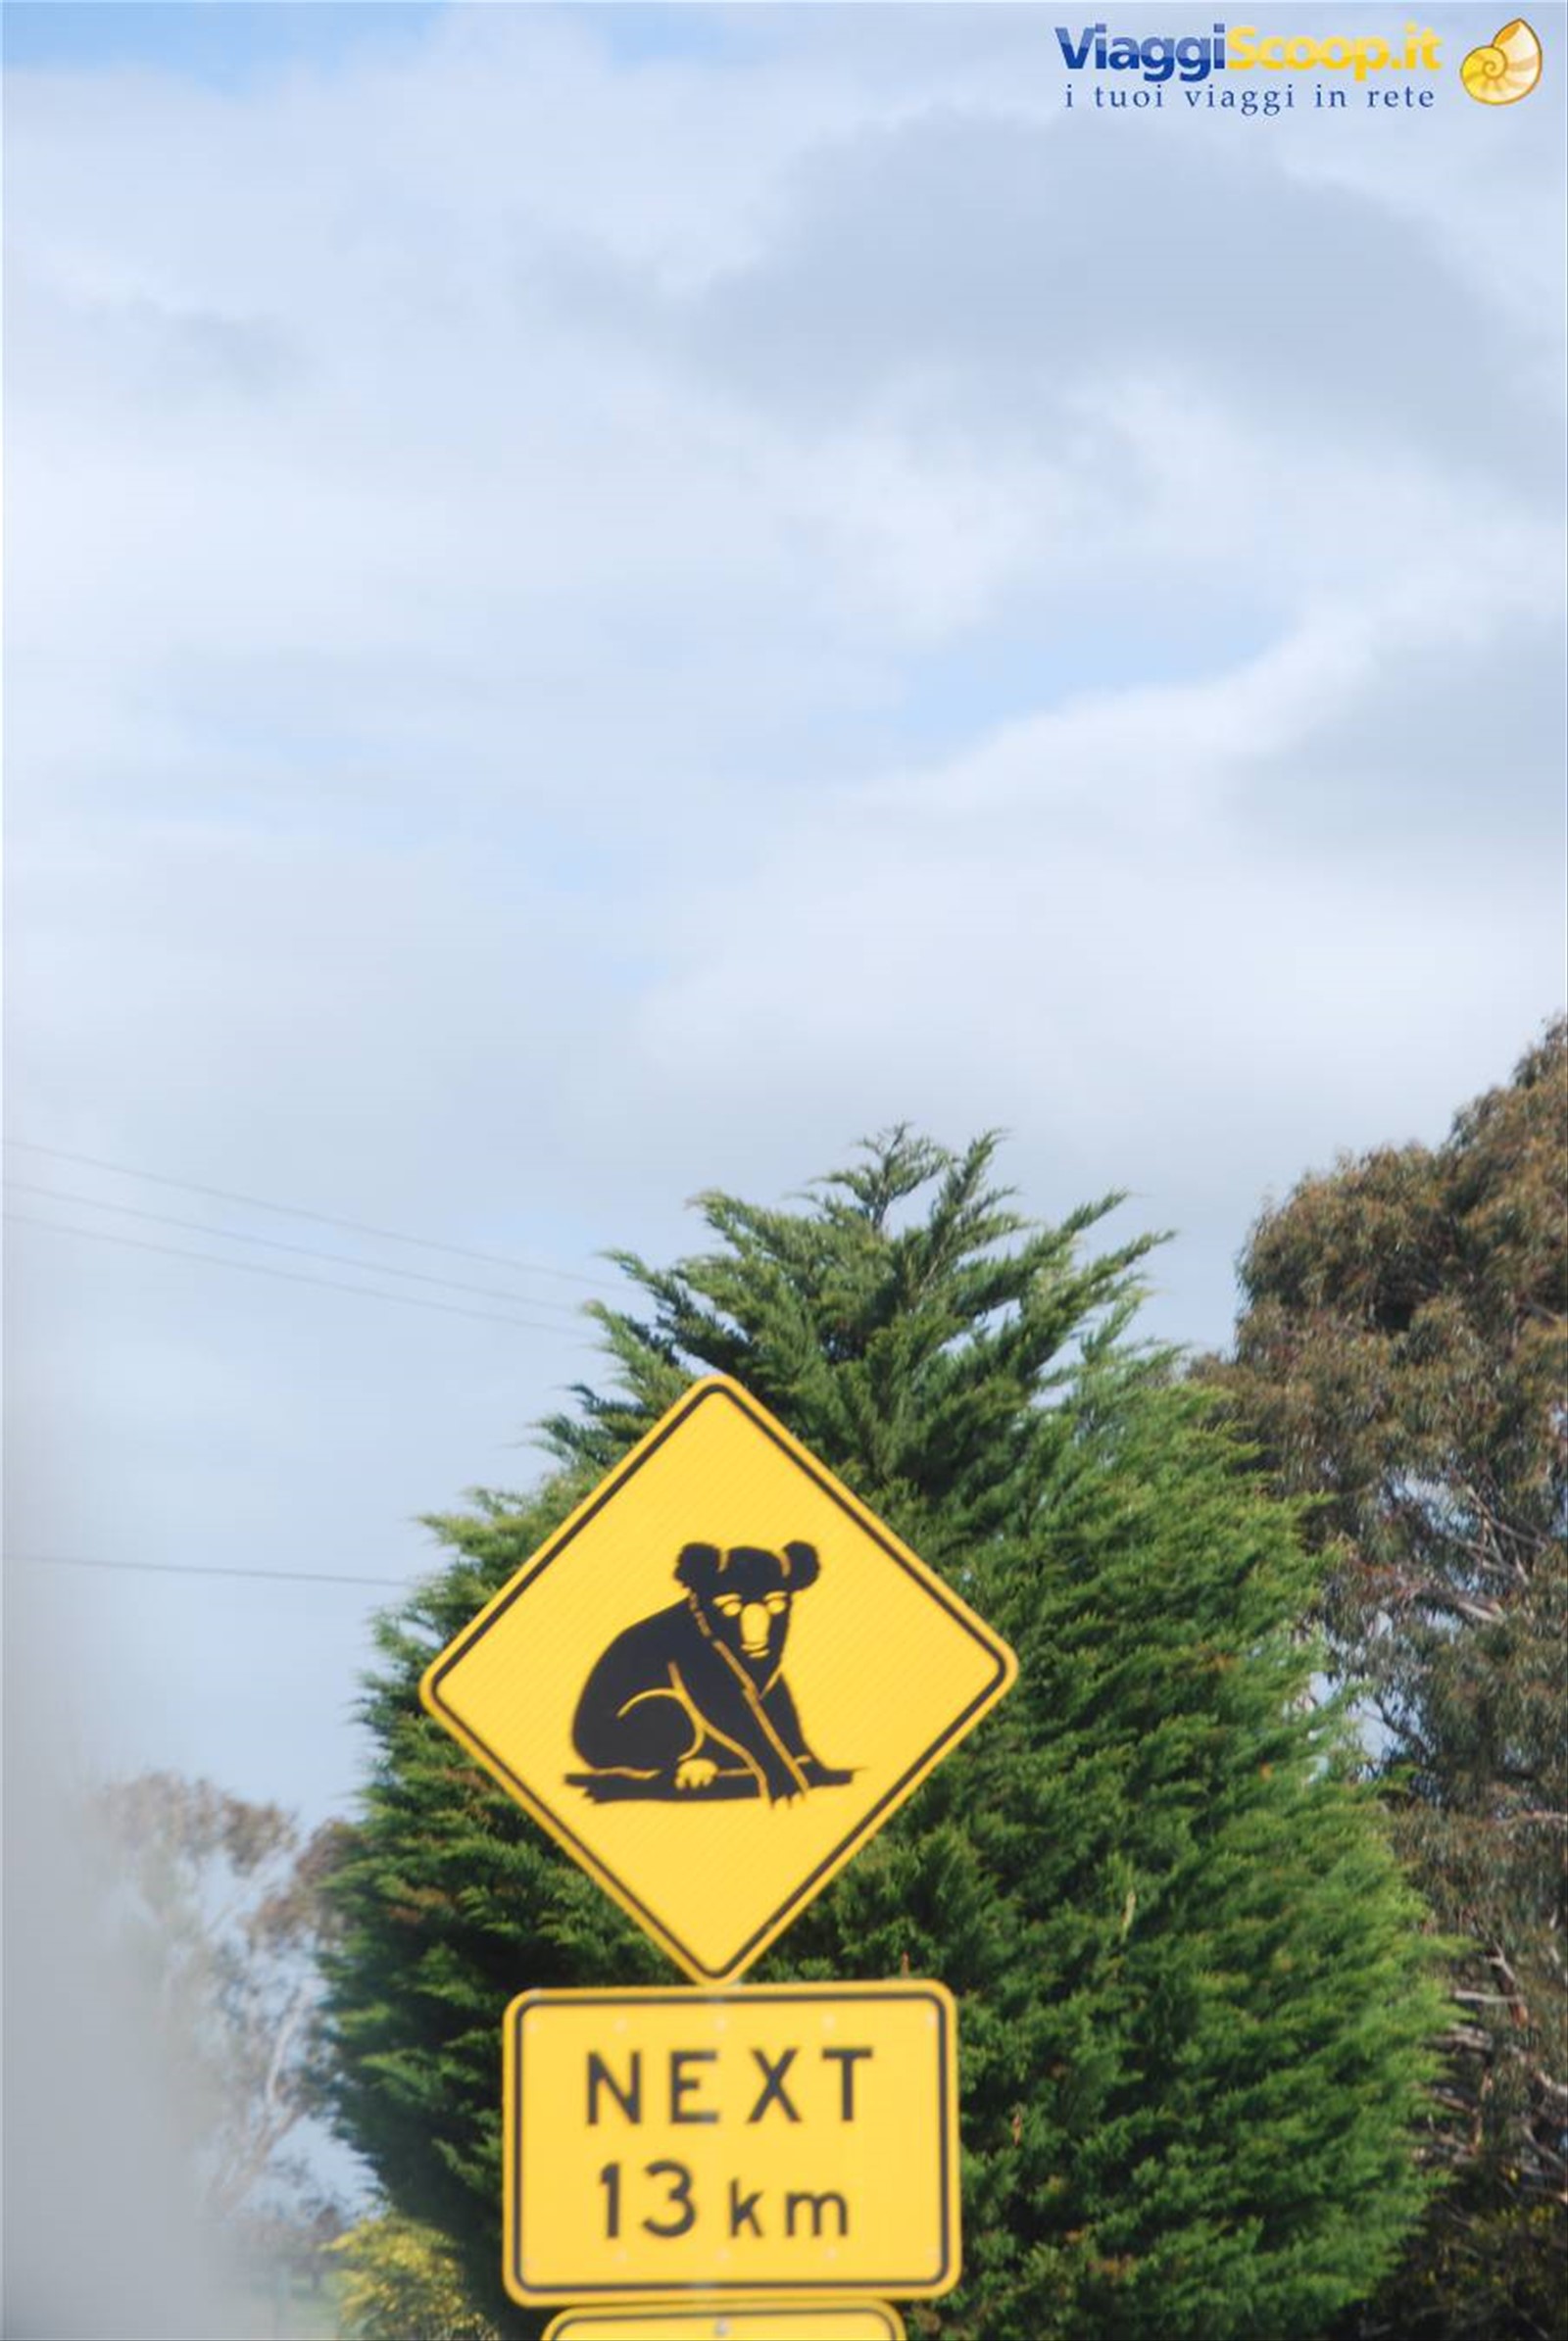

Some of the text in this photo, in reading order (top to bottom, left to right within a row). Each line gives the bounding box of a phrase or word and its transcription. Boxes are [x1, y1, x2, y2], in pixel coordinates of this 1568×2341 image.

[586, 2046, 873, 2125] NEXT
[600, 2160, 849, 2239] 13 km
